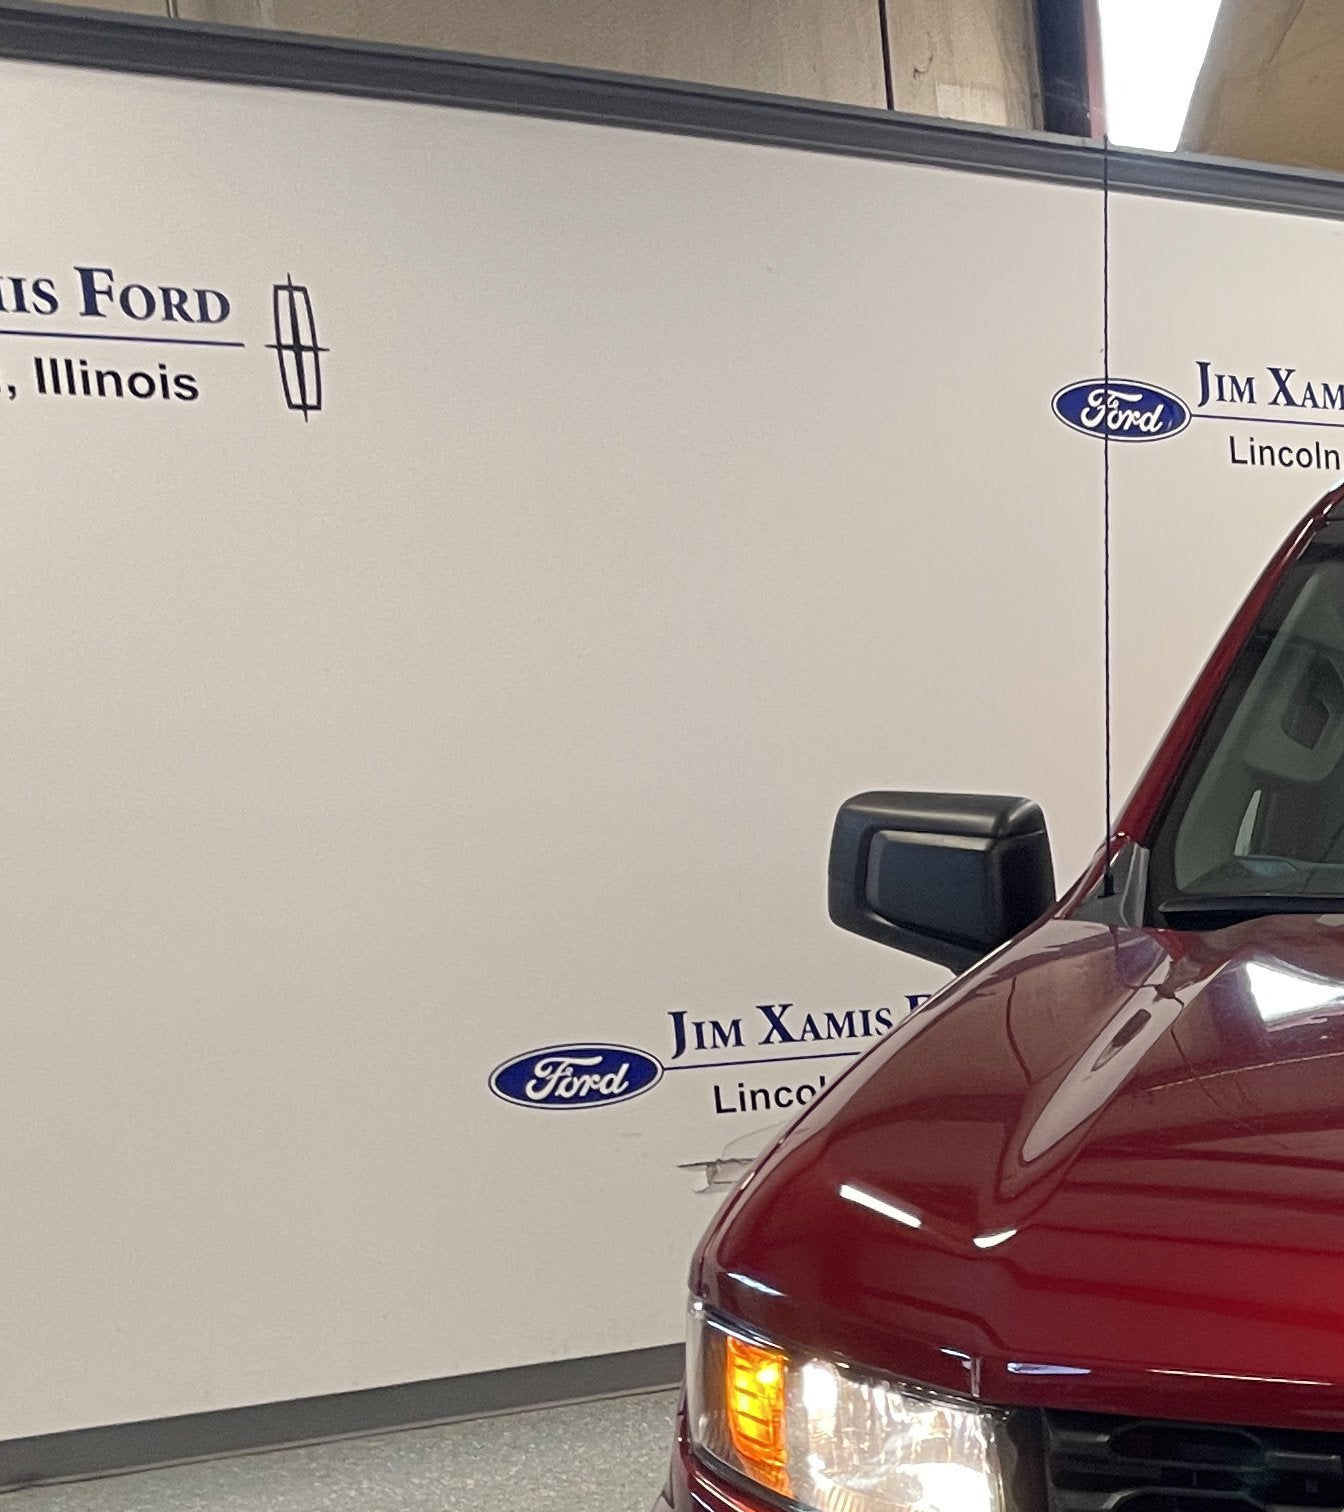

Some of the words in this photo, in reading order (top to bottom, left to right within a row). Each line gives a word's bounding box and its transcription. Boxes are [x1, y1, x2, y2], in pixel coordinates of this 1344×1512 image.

[73, 266, 230, 323] FORD
[34, 357, 199, 401] Illinois
[1195, 360, 1256, 408] JIM
[1080, 389, 1164, 433] Ford
[667, 1010, 745, 1060] JIM
[755, 1003, 893, 1046] XAMIS
[525, 1055, 630, 1100] Ford
[713, 1075, 826, 1115] Linco
